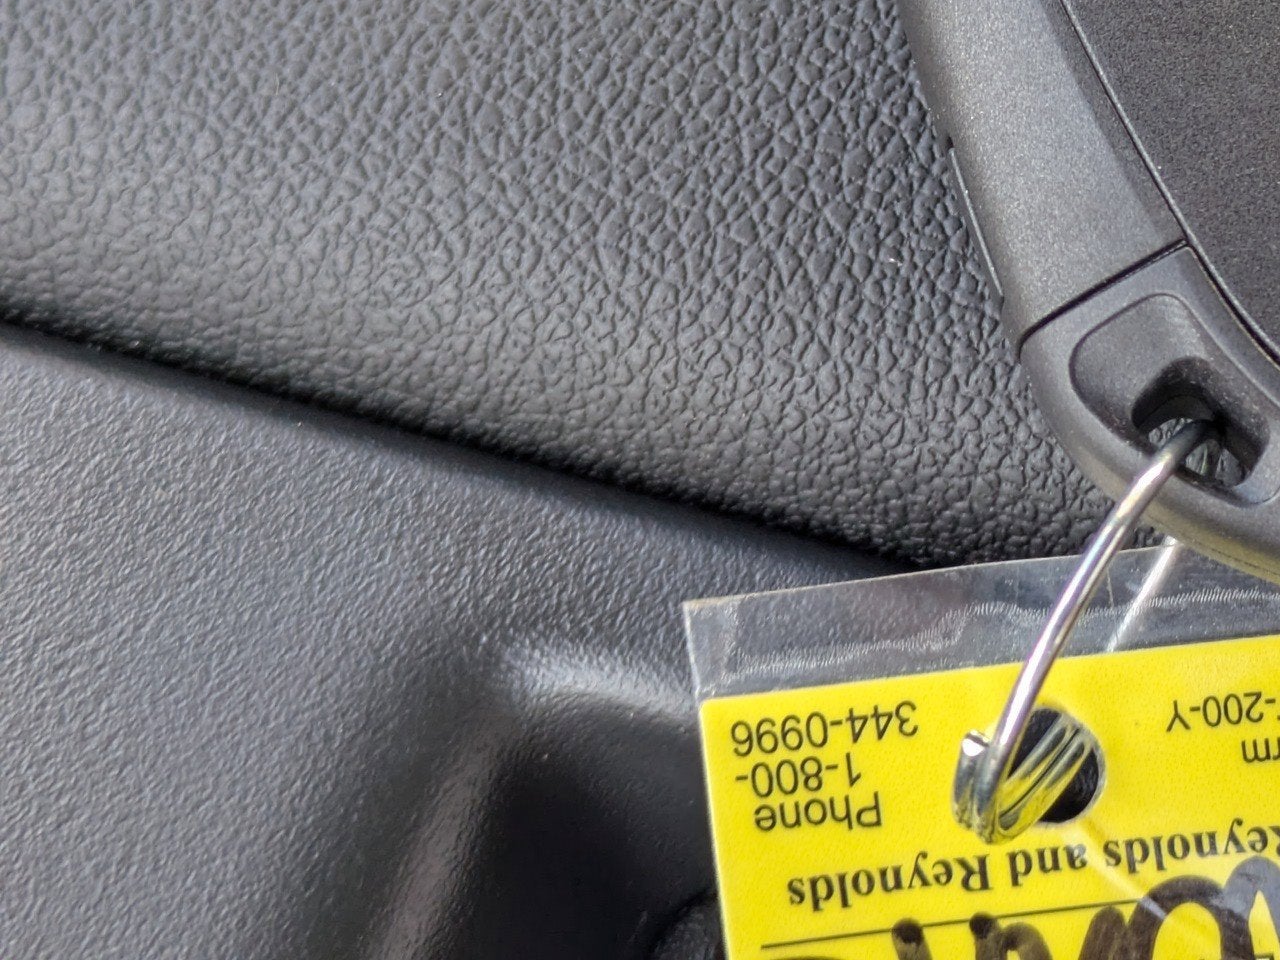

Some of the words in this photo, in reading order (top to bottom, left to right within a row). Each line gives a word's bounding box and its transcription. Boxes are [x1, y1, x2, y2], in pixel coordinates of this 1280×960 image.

[730, 700, 919, 757] 344-0996
[735, 752, 861, 798] 1-800-
[754, 791, 882, 831] Phone
[787, 851, 993, 912] Reynolds
[1009, 843, 1088, 887] and
